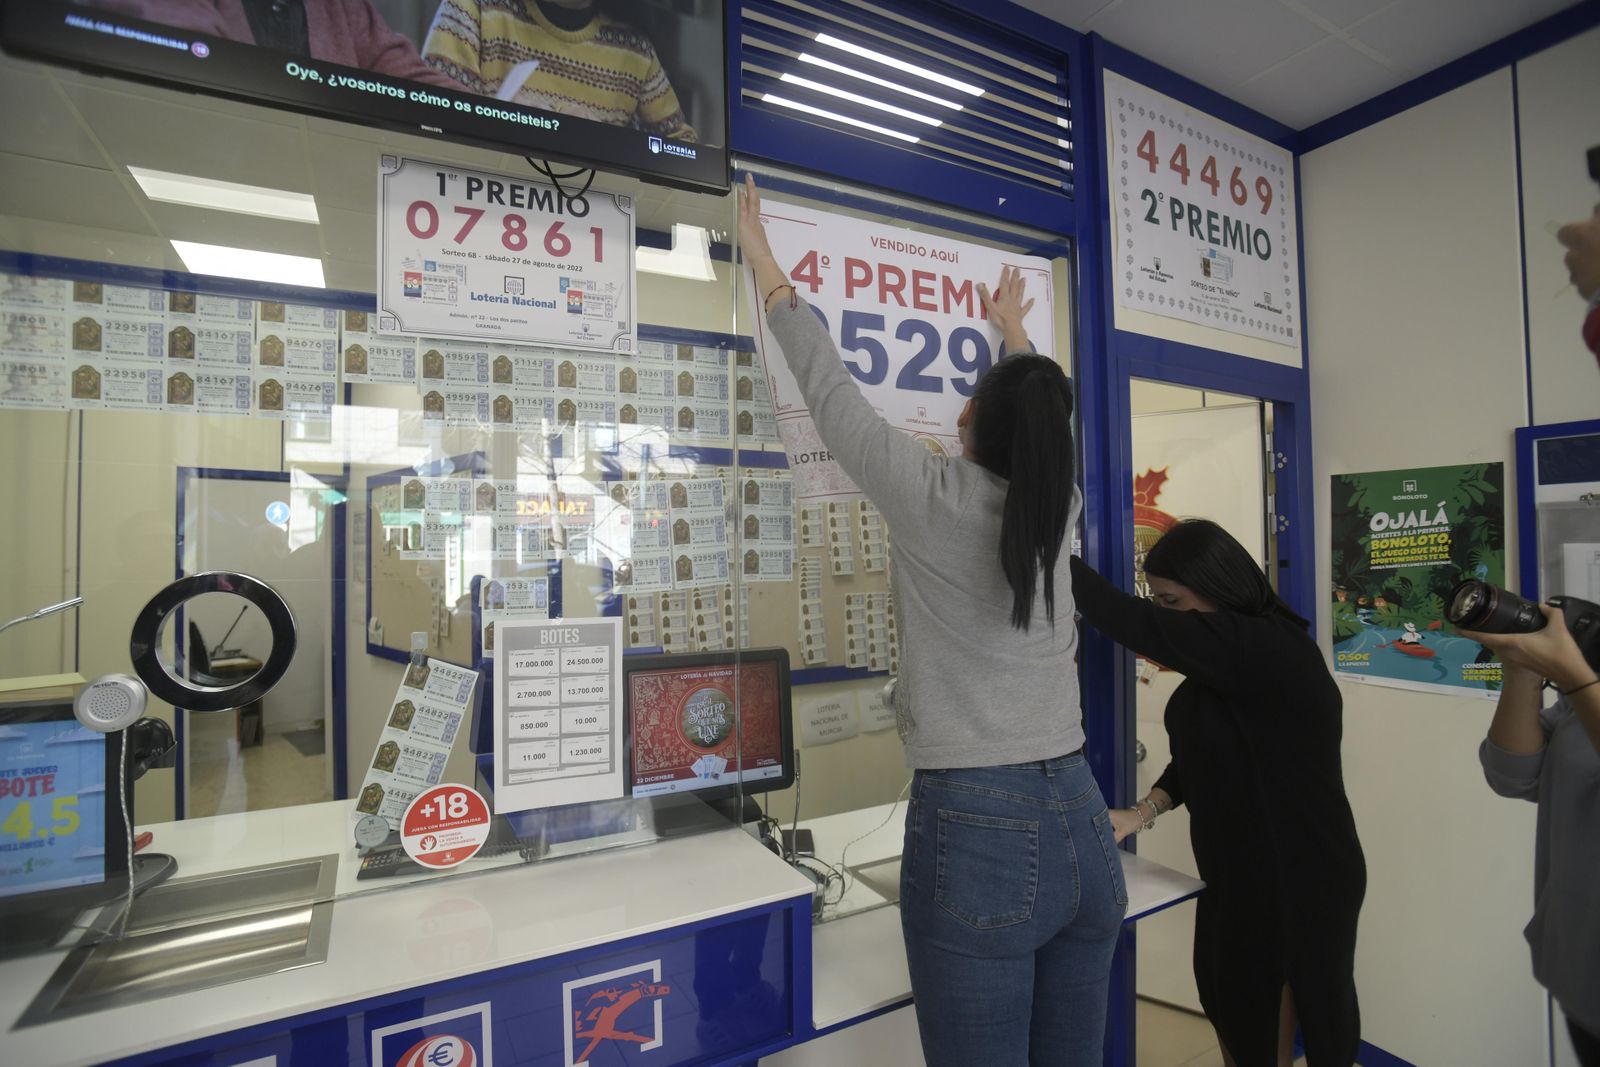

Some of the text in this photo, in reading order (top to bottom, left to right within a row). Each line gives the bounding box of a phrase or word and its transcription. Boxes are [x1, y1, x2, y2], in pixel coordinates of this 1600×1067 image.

[286, 62, 560, 131] Oye, ¿vosotros cómo os conocisteis?
[663, 143, 696, 156] LOTERÍAS
[1136, 129, 1273, 216] 44469
[466, 176, 590, 218] PREMIO
[406, 200, 604, 263] 07861
[1169, 196, 1272, 262] PREMIO
[870, 236, 960, 264] VENDIDO AQUÍ
[441, 248, 466, 258] Sorteo
[485, 253, 511, 263] sábado
[522, 258, 532, 266] de
[533, 260, 556, 270] agosto
[556, 262, 566, 270] de
[567, 264, 583, 272] 2022
[1208, 285, 1216, 293] DE
[512, 296, 557, 309] Nacional
[105, 321, 147, 332] 22958
[197, 330, 236, 341] 84167
[286, 338, 322, 348] 94676
[807, 303, 1037, 398] 529
[445, 352, 476, 361] 49594
[104, 369, 146, 380] 22958
[196, 375, 234, 386] 84167
[285, 382, 321, 392] 94676
[445, 393, 476, 402] 49594
[1369, 500, 1449, 532] OJALÁ
[1408, 529, 1417, 537] LA
[1371, 532, 1452, 550] BONOLOTO,
[1381, 548, 1409, 557] JUEGO
[1410, 546, 1430, 555] QUE
[1430, 544, 1449, 553] MÁS
[1370, 555, 1428, 565] OPORTUNIDADES
[540, 628, 580, 645] BOTES
[515, 660, 554, 668] 17.000.000
[567, 657, 604, 666] 24.500.000
[433, 666, 464, 680] 44822
[517, 690, 552, 699] 2.700.000
[567, 687, 604, 695] 13.700.000
[418, 706, 449, 720] 44822
[520, 721, 549, 730] 850.000
[575, 717, 597, 725] 10.000
[403, 747, 434, 760] 44822
[523, 753, 546, 761] 11.000
[570, 747, 602, 757] 1.230.000
[644, 773, 675, 783] DICIEMBRE
[420, 792, 469, 820] +18
[3, 795, 80, 841] 4.5
